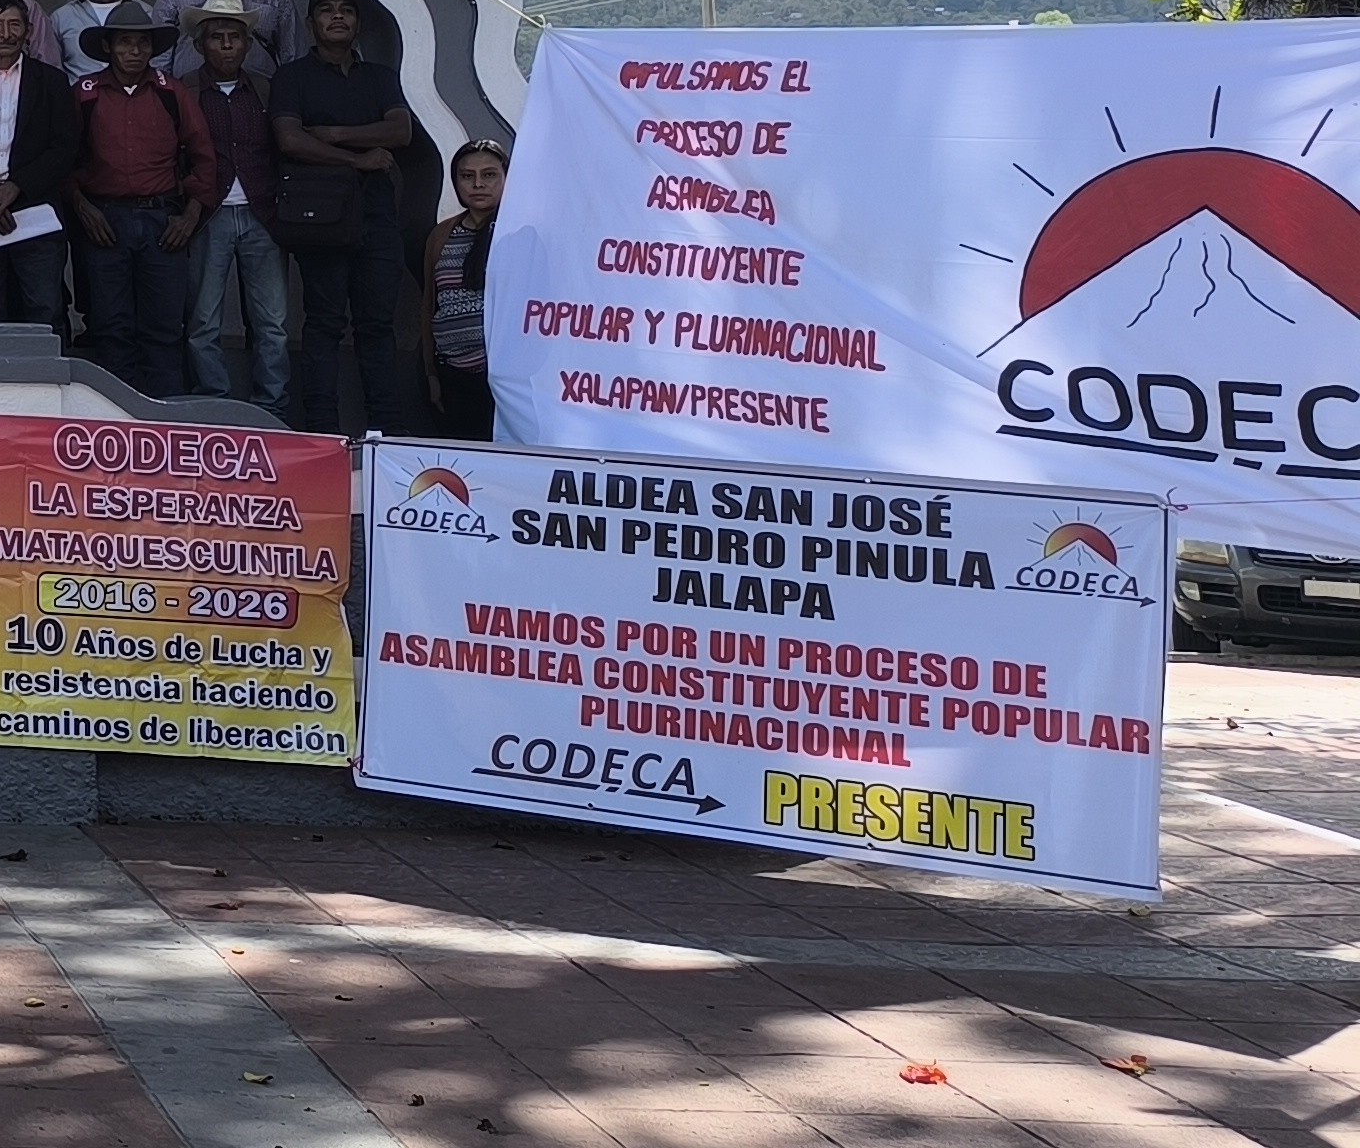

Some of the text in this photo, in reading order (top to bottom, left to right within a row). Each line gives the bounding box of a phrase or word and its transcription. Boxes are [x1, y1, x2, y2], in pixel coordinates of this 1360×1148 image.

[781, 60, 810, 92] EL
[637, 120, 791, 157] PROCESO DE
[647, 175, 775, 226] ASAMBLEA
[597, 238, 804, 288] CONSTITUYENTE
[523, 299, 886, 372] POPULAR Y PLURINACIONAL
[560, 369, 831, 433] XALAPAN/PRESENTE
[54, 424, 277, 481] CODECA
[30, 482, 302, 530] LA ESPERANZA
[385, 507, 487, 535] CODECA
[547, 469, 952, 541] ALDEA SAN JOSÉ
[512, 511, 995, 591] SAN PEDRO PINULA
[54, 576, 156, 613] 2016
[188, 584, 289, 621] 2026
[653, 566, 835, 621] JALAPA
[1015, 566, 1140, 598] CODECA
[5, 616, 64, 653] 10
[73, 630, 156, 660] Años
[164, 635, 201, 663] de
[211, 635, 303, 668] Lucha
[310, 646, 331, 673] y
[464, 602, 1048, 700] VAMOS POR UN PROCESO DE
[2, 668, 335, 714] resistencia haciendo
[379, 632, 1150, 755] ASAMBLEA CONSTITUYENTE POPULAR
[137, 714, 179, 746] de
[188, 708, 346, 755] liberación
[579, 694, 912, 769] PLURINACIONAL
[491, 733, 1036, 862] CODECA PRESENTE
